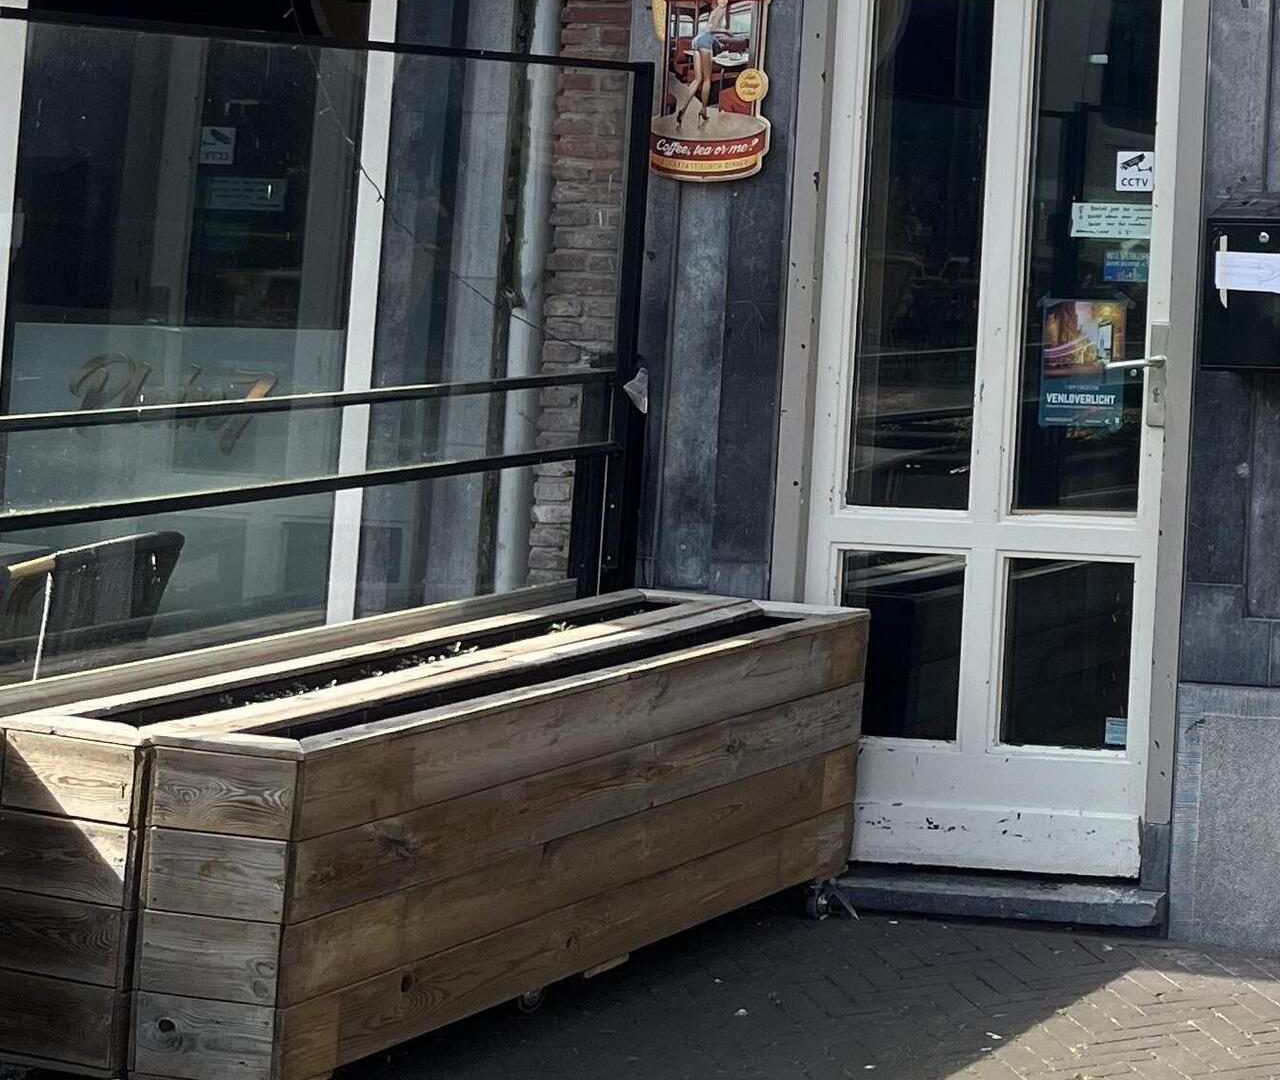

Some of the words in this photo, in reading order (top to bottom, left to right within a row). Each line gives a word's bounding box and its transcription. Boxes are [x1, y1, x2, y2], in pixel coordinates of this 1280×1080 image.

[656, 138, 691, 157] Coffee,
[1120, 177, 1149, 187] CCTV
[1046, 392, 1116, 405] VENLOVERLICHT
